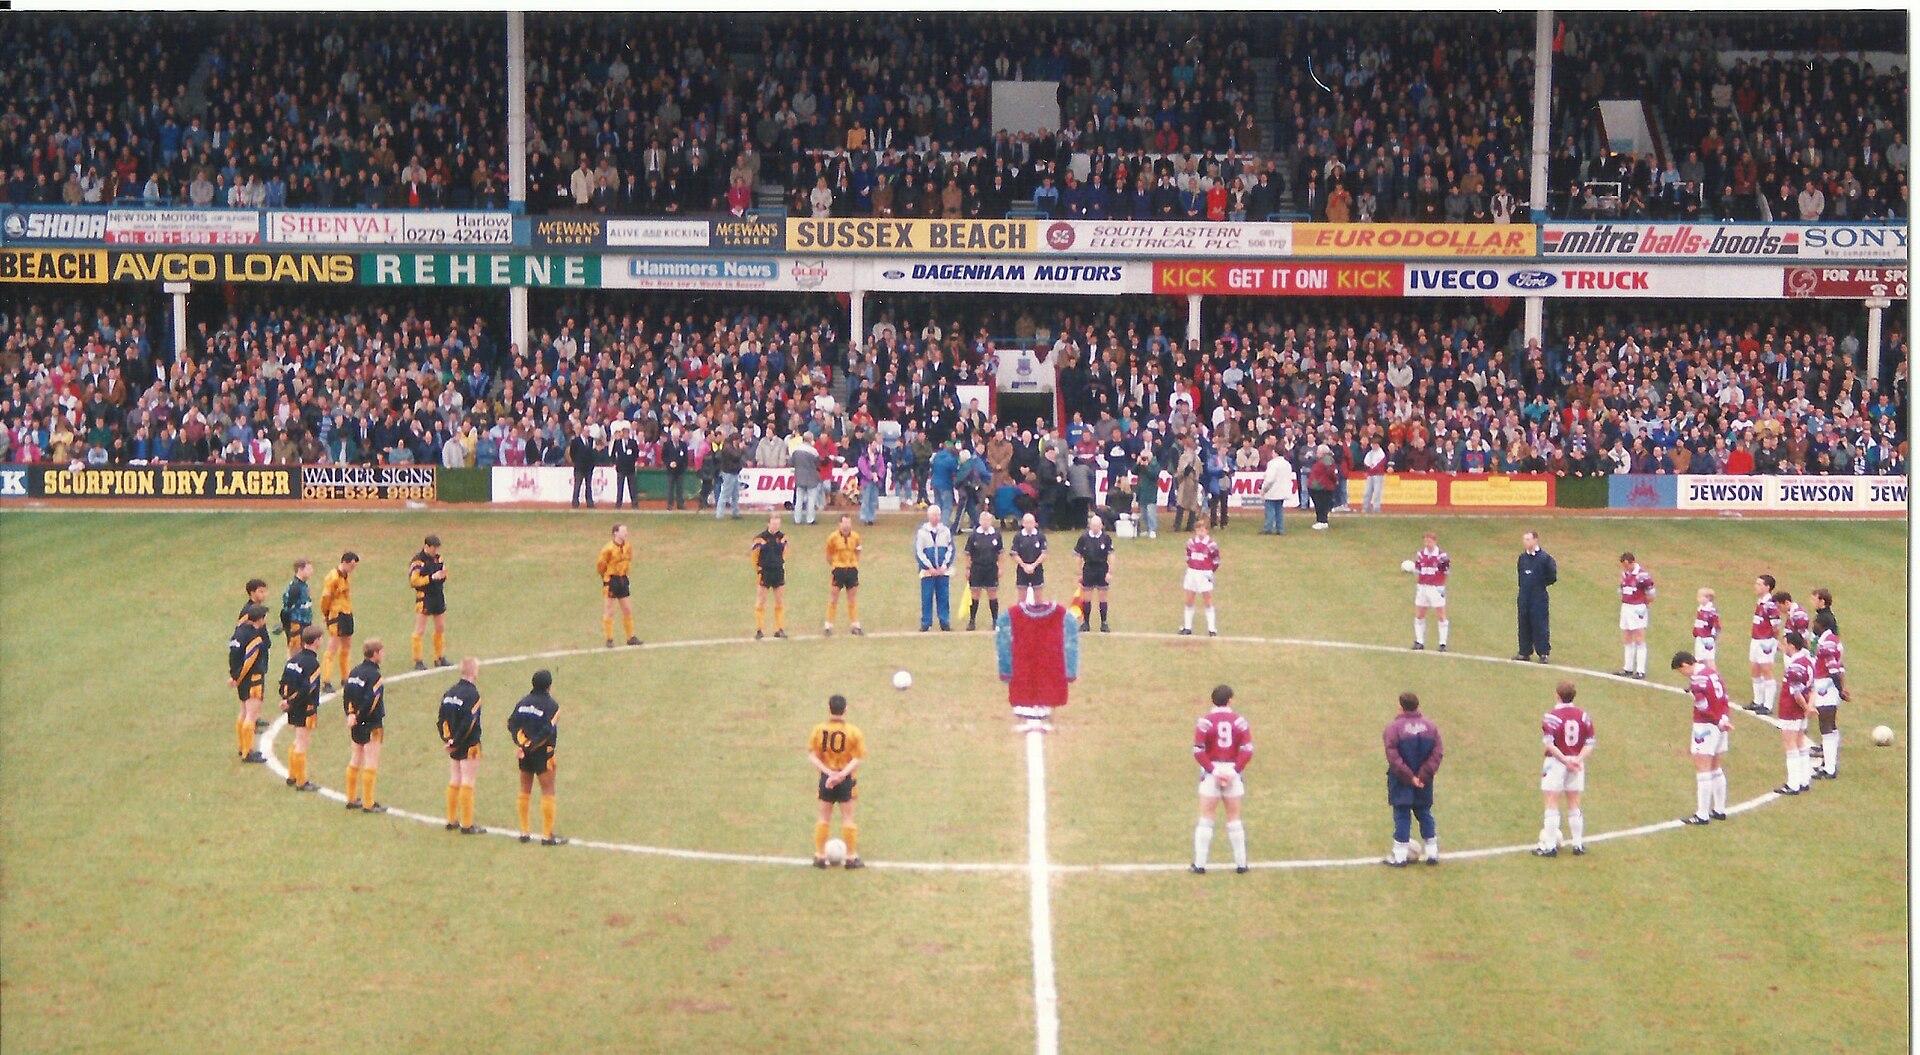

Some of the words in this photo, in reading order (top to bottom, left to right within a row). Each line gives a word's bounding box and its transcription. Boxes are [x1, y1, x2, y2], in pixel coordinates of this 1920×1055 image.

[26, 213, 106, 239] SKODA
[109, 213, 157, 222] NEWTON
[161, 213, 207, 222] MOTORS
[281, 215, 399, 233] SHENVAL
[456, 215, 509, 227] Harlow
[610, 228, 637, 238] ALIVE
[664, 228, 707, 239] KICKING
[725, 237, 769, 245] LAGER
[797, 222, 914, 248] SUSSEX
[931, 223, 1027, 249] BEACH
[1093, 226, 1153, 236] SOUTH
[1163, 228, 1242, 238] EASTERN
[1315, 229, 1525, 248] EURODOLLAR
[1558, 225, 1638, 253] mitre
[1805, 227, 1907, 248] SONY
[1090, 237, 1196, 248] ELECTRICAL
[1, 253, 96, 279] BEACH
[113, 253, 217, 281] AVCO
[225, 254, 355, 282] LOANS
[376, 254, 586, 285] REHENE
[636, 259, 718, 276] Hammers
[724, 261, 772, 277] News
[912, 264, 1025, 281] DAGENHAM
[1034, 265, 1122, 282] MOTORS
[1822, 269, 1850, 282] FOR
[1854, 269, 1879, 282] ALL
[1162, 268, 1217, 287] KICK
[1229, 268, 1264, 289] GET
[1272, 268, 1291, 288] IT
[1296, 269, 1328, 289] ON!
[1337, 269, 1392, 289] KICK
[1410, 269, 1499, 290] IVECO
[1515, 271, 1547, 288] Ford
[1561, 270, 1650, 290] TRUCK
[1, 471, 27, 495] K
[44, 470, 155, 495] SCORPION
[162, 470, 208, 495] DRY
[215, 470, 291, 495] LAGER
[304, 468, 380, 486] WALKER
[382, 468, 433, 486] SIGNS
[303, 486, 379, 499] 081-532
[387, 486, 434, 499] 9988
[1690, 484, 1763, 501] JEWSON
[1780, 485, 1854, 502] JEWSON
[822, 730, 846, 753] 10
[1217, 721, 1233, 748] 9
[1564, 719, 1580, 747] 8
